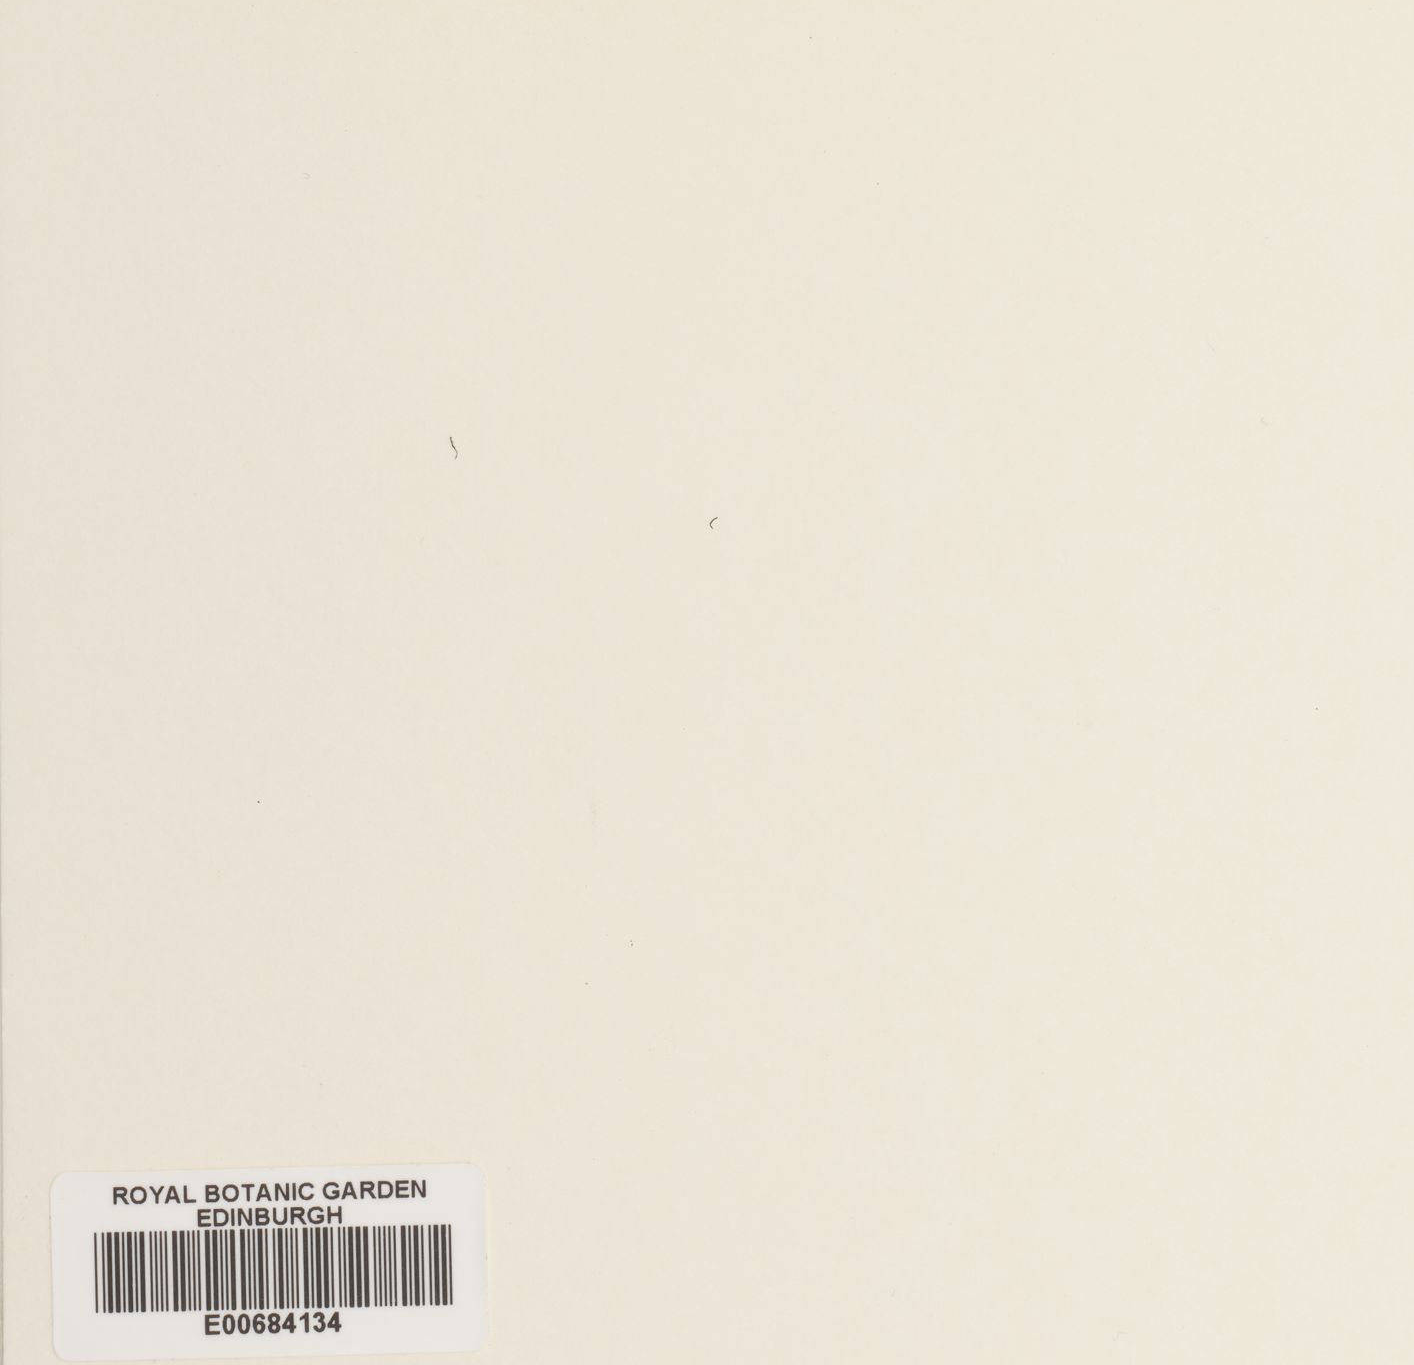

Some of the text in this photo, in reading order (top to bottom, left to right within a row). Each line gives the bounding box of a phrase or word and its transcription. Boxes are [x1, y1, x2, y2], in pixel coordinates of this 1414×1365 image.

[112, 1179, 427, 1206] ROYAL BOTANIC GARDEN
[196, 1205, 343, 1228] EDINBURGH
[204, 1311, 343, 1336] E00684134
